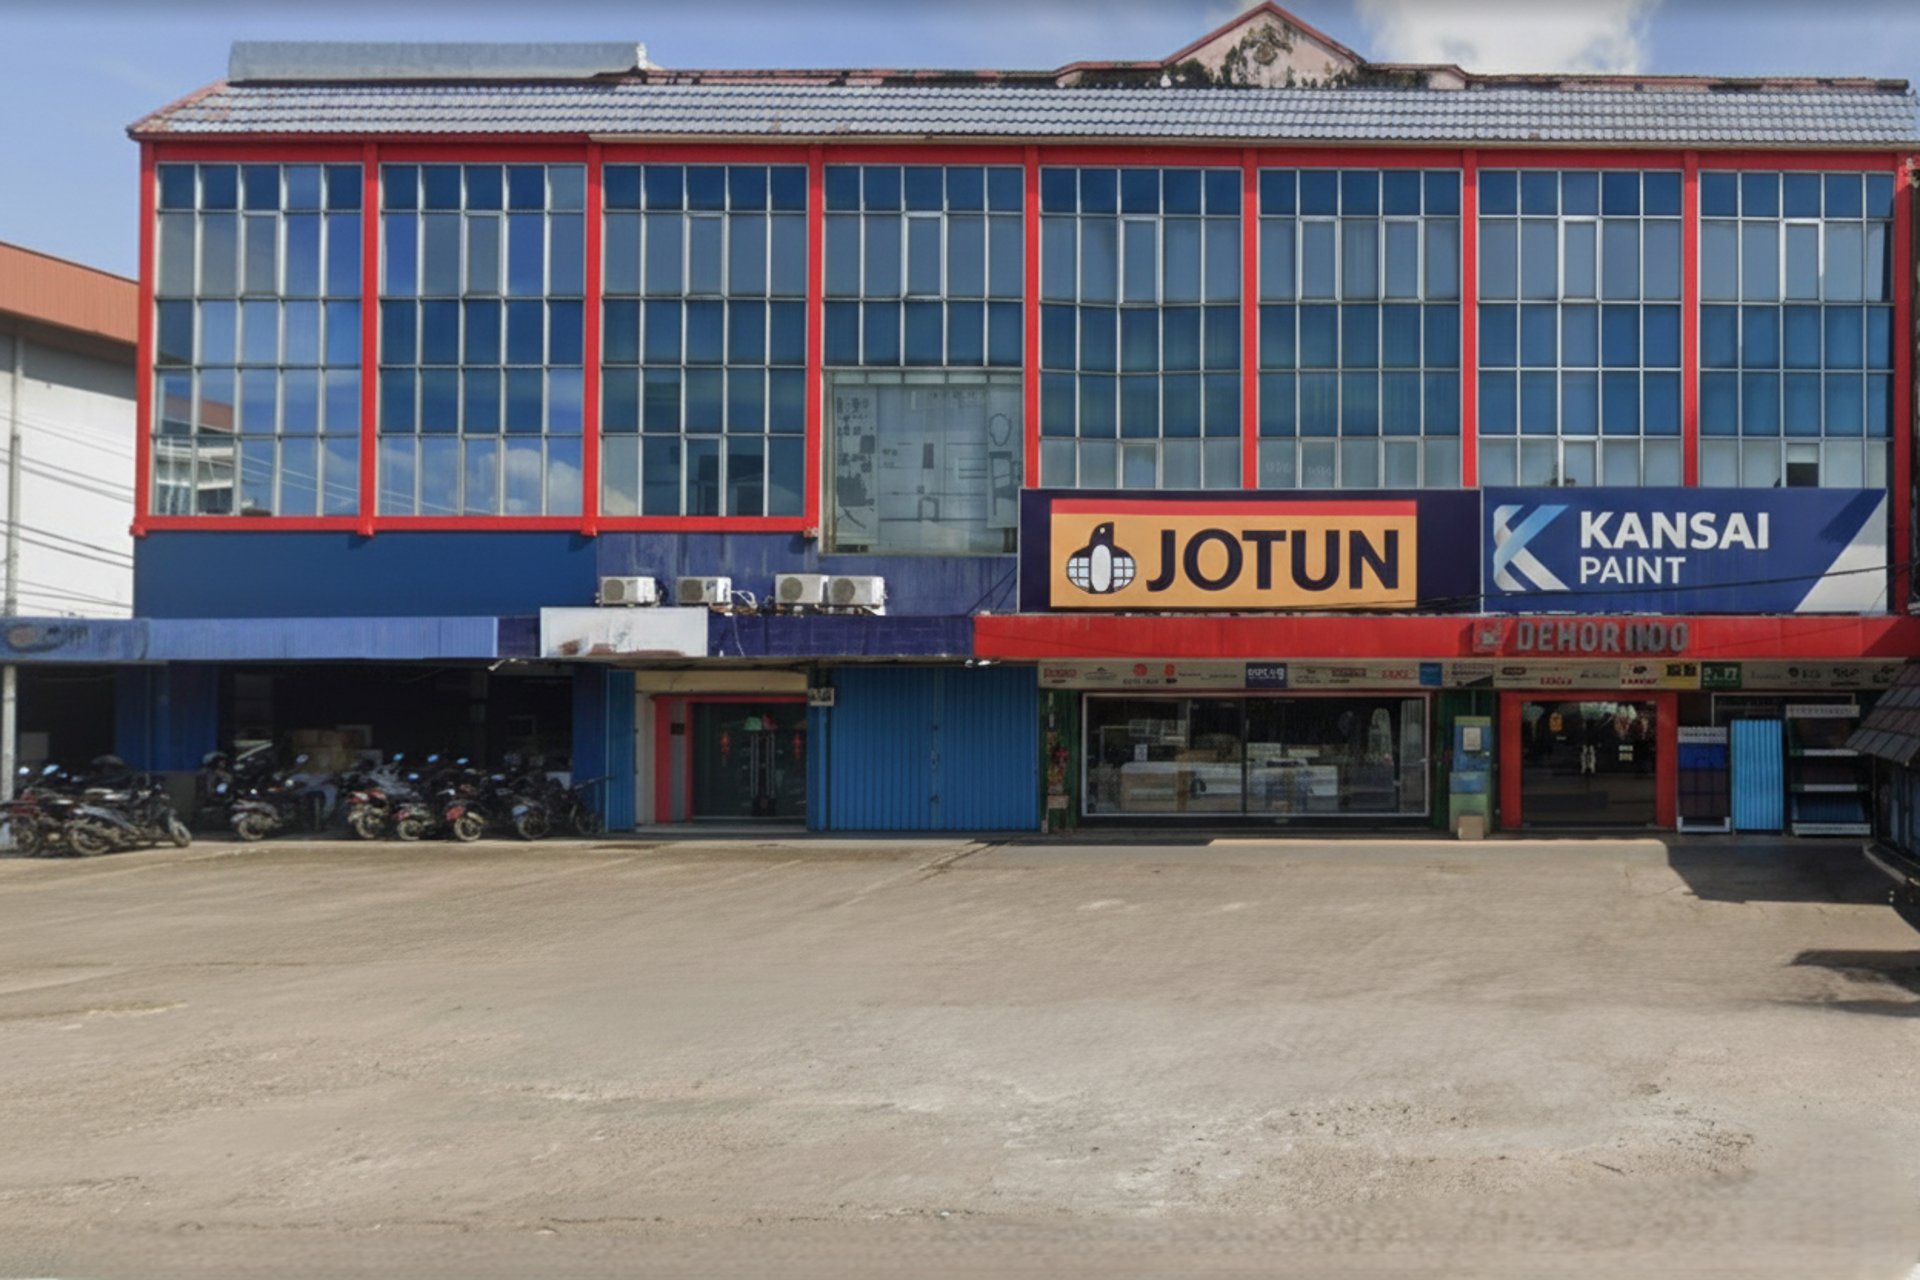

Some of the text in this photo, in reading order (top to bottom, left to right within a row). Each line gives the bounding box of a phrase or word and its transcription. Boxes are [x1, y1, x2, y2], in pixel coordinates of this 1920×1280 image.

[1580, 511, 1769, 550] KANSAI
[1146, 528, 1399, 593] JOTUN
[1580, 556, 1686, 584] PAINT
